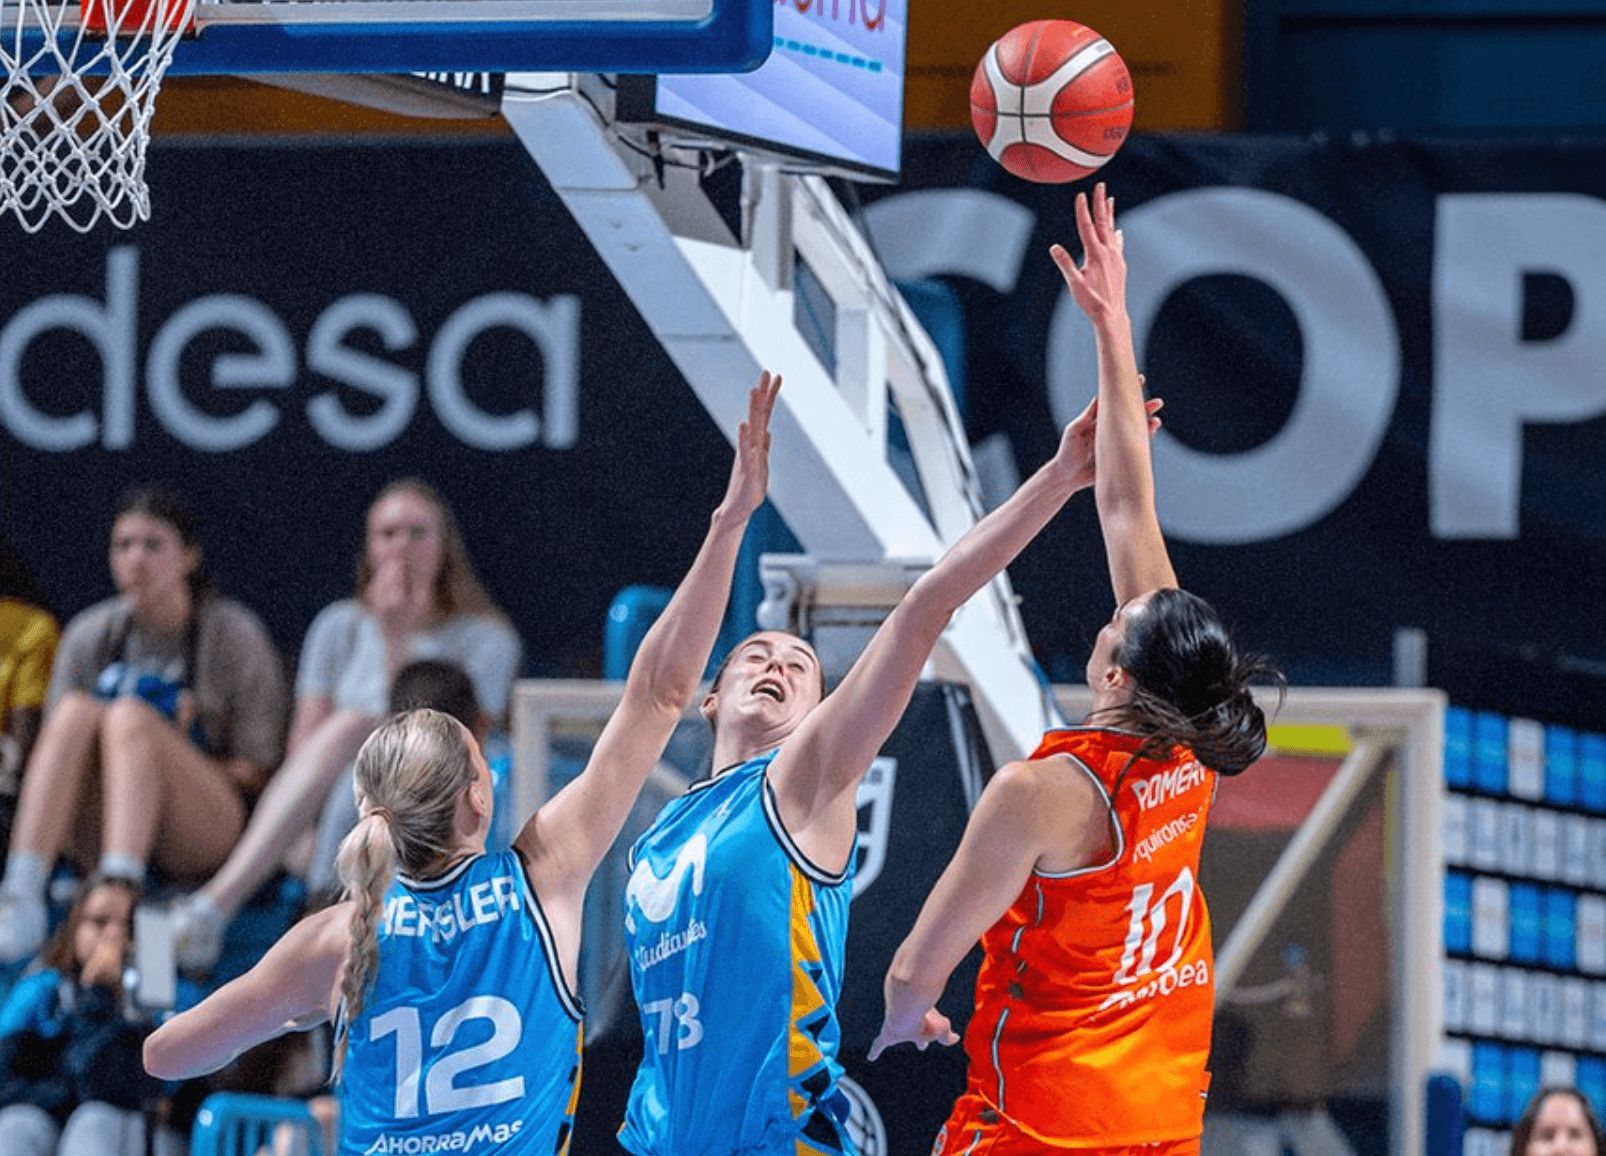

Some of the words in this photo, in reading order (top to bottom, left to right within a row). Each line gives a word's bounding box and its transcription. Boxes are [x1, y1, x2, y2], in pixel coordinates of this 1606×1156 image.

[0, 246, 582, 453] desa
[1113, 866, 1194, 985] 10
[369, 995, 526, 1119] 12
[643, 992, 704, 1055] 78
